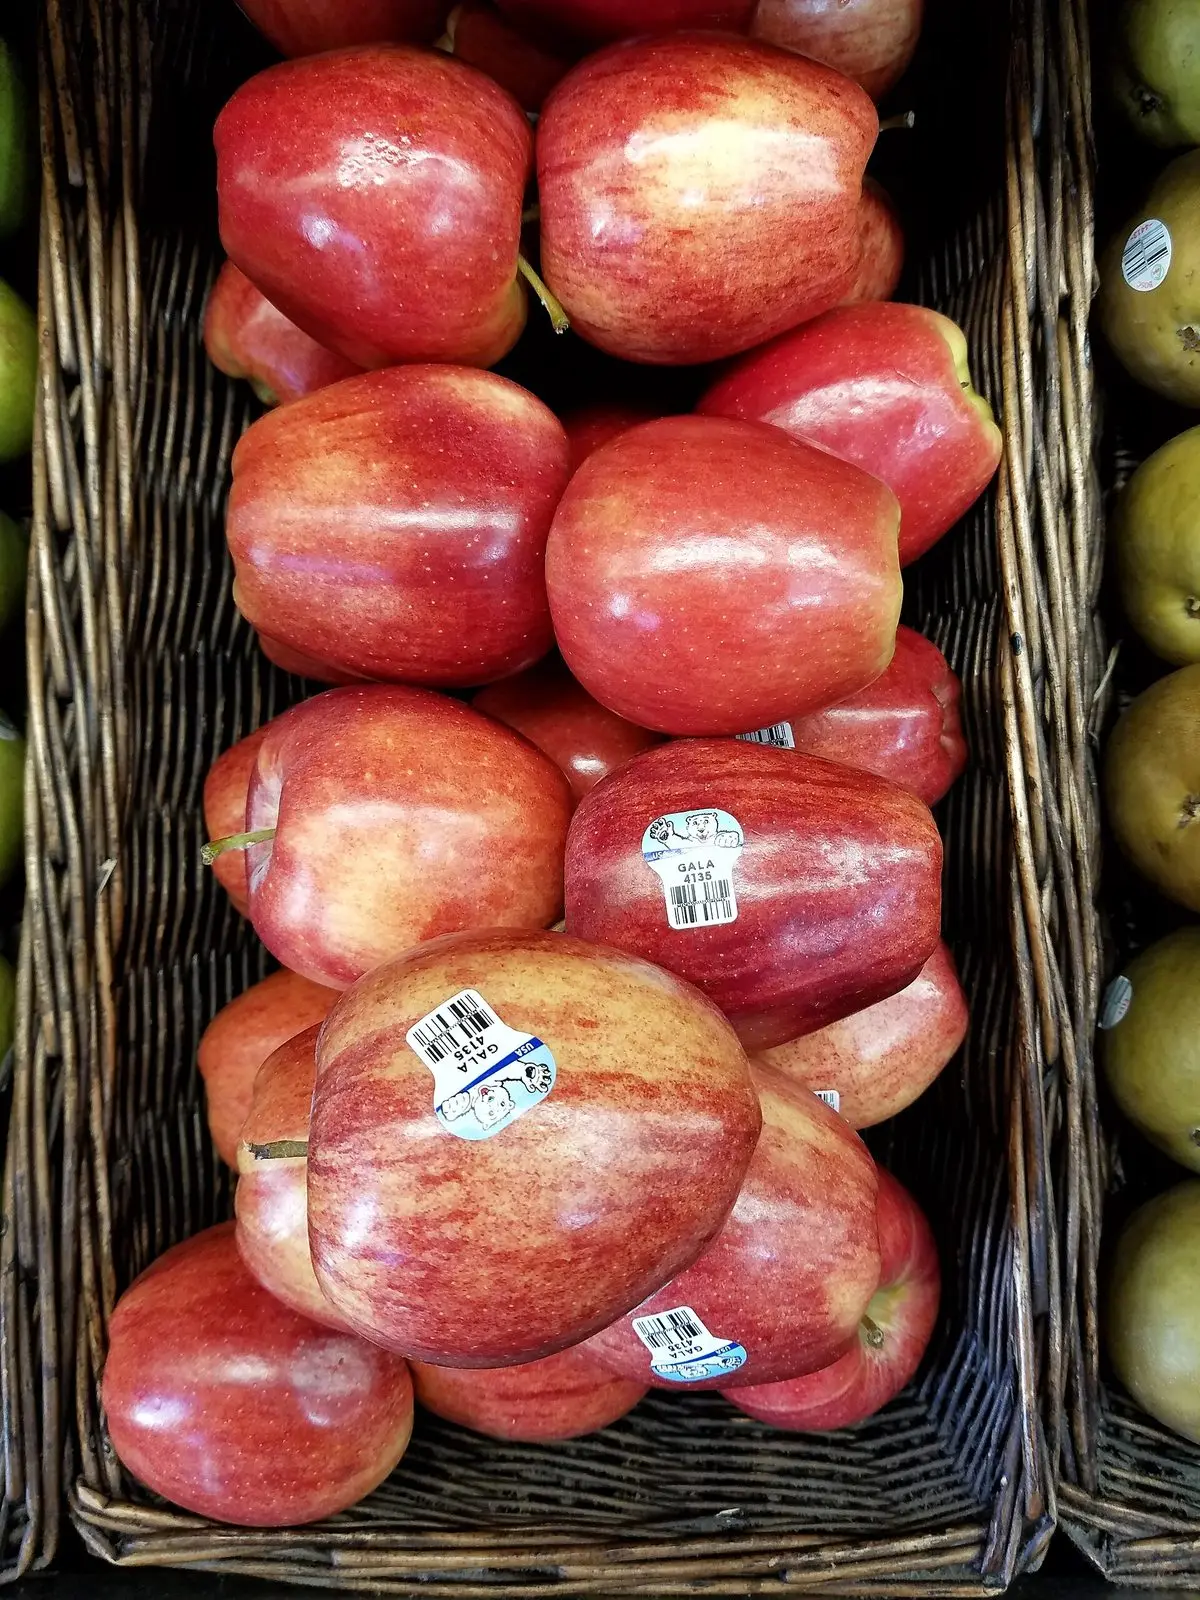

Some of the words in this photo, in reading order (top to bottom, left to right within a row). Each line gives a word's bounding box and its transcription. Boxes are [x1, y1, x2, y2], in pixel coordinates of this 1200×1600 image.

[678, 860, 715, 872] GALA
[684, 871, 712, 884] 4135
[454, 1036, 484, 1061] 4135
[514, 1042, 534, 1056] USA
[457, 1043, 498, 1073] GALA
[668, 1340, 693, 1352] 4135
[669, 1345, 703, 1359] GALA
[715, 1345, 731, 1354] USA
